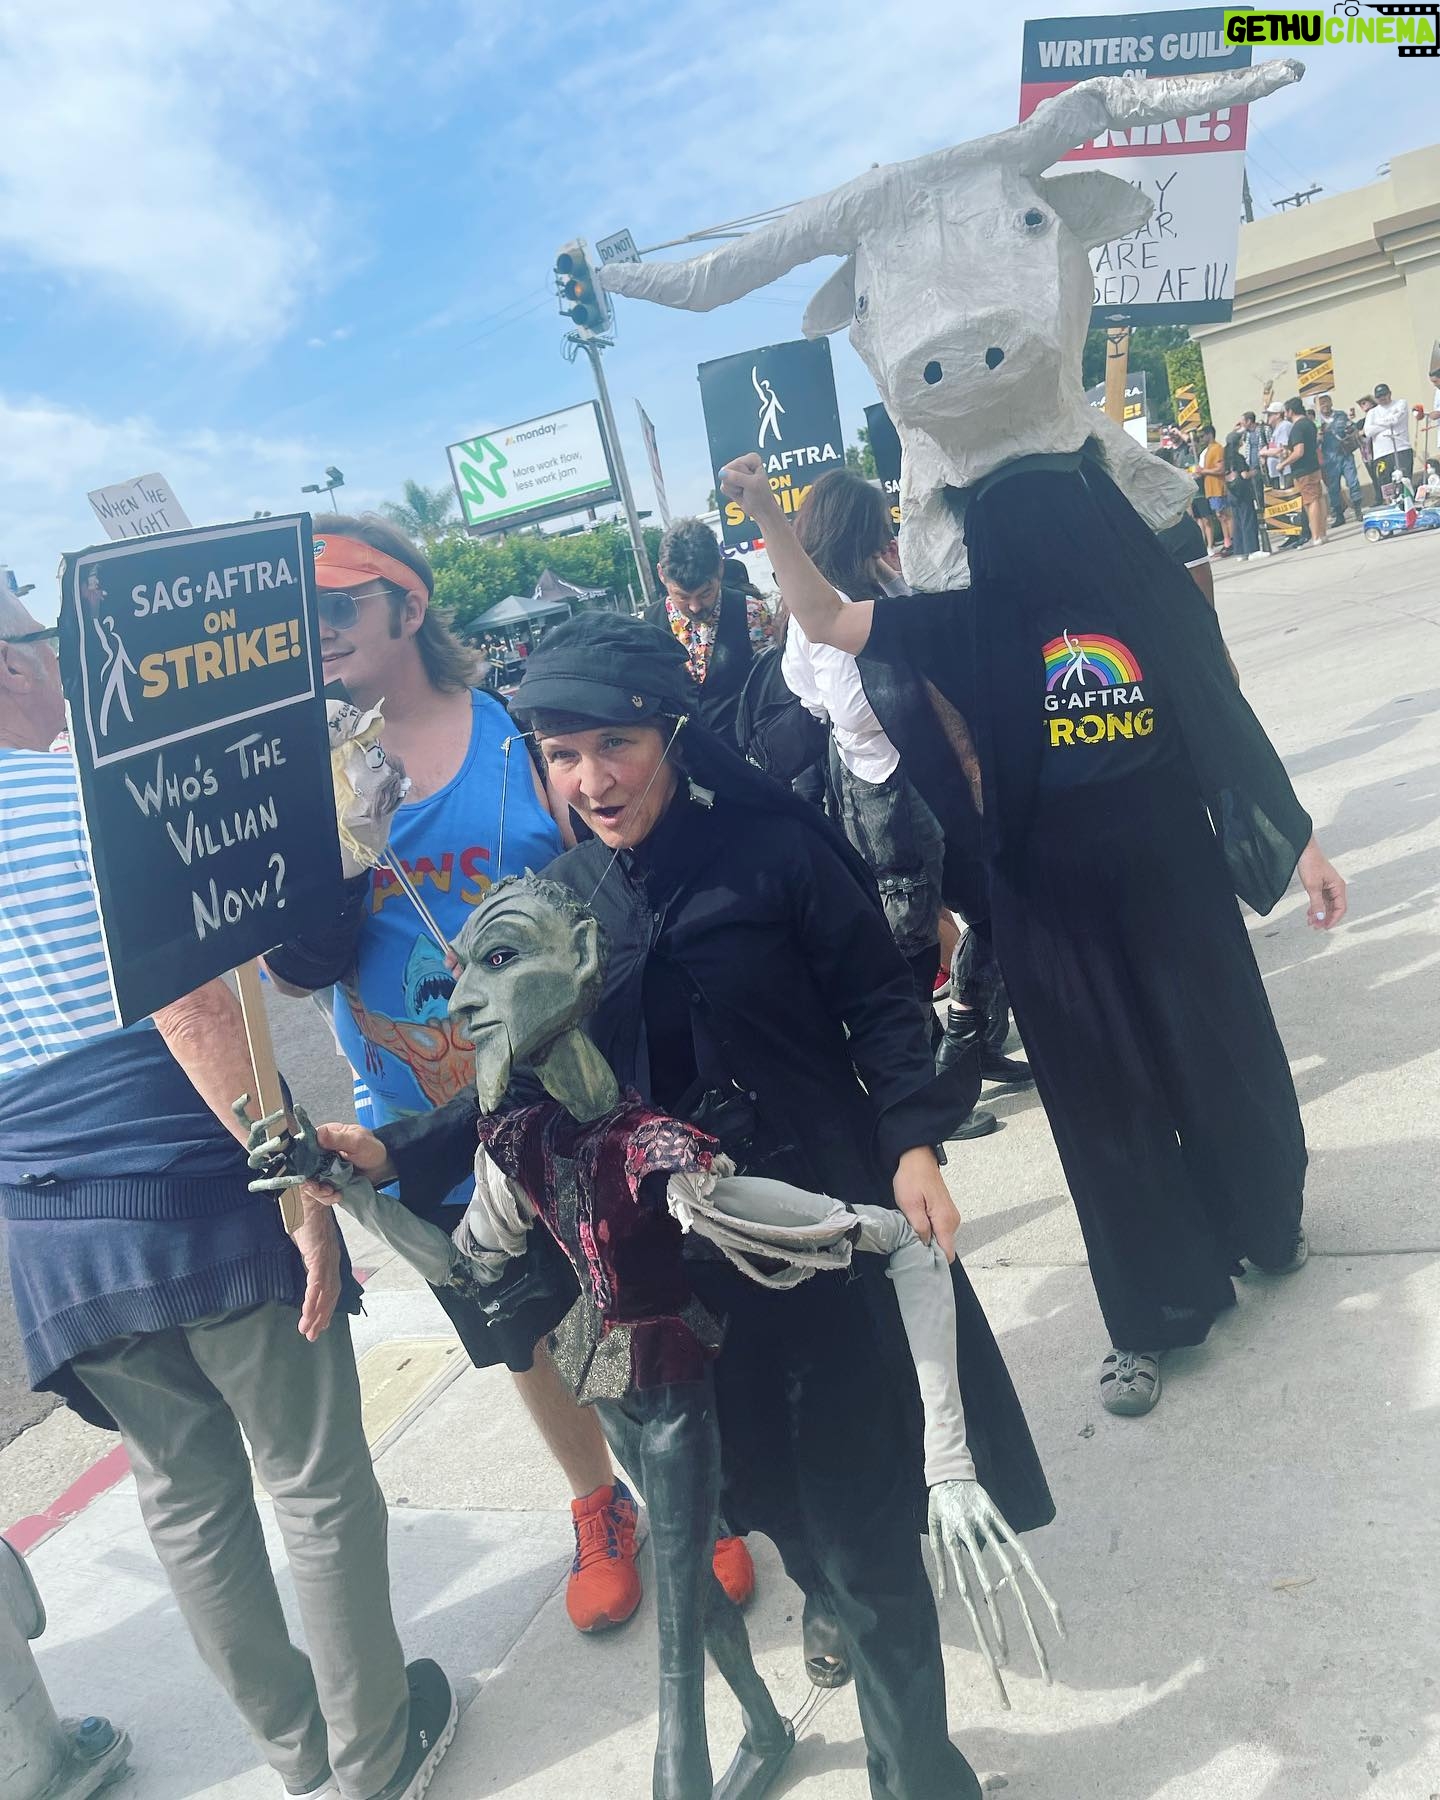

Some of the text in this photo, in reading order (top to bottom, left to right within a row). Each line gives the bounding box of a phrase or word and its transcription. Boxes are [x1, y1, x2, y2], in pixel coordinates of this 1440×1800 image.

[1038, 35, 1154, 68] WRITERS
[1096, 241, 1160, 272] ARE
[513, 464, 535, 478] More
[536, 457, 559, 470] work
[515, 466, 577, 491] less work jam
[89, 480, 167, 519] WHEN THE
[203, 608, 237, 634] ON
[139, 618, 301, 698] STRIKE!
[1043, 708, 1153, 747] RONG
[225, 732, 287, 780] THE
[166, 795, 278, 866] VILLIAN
